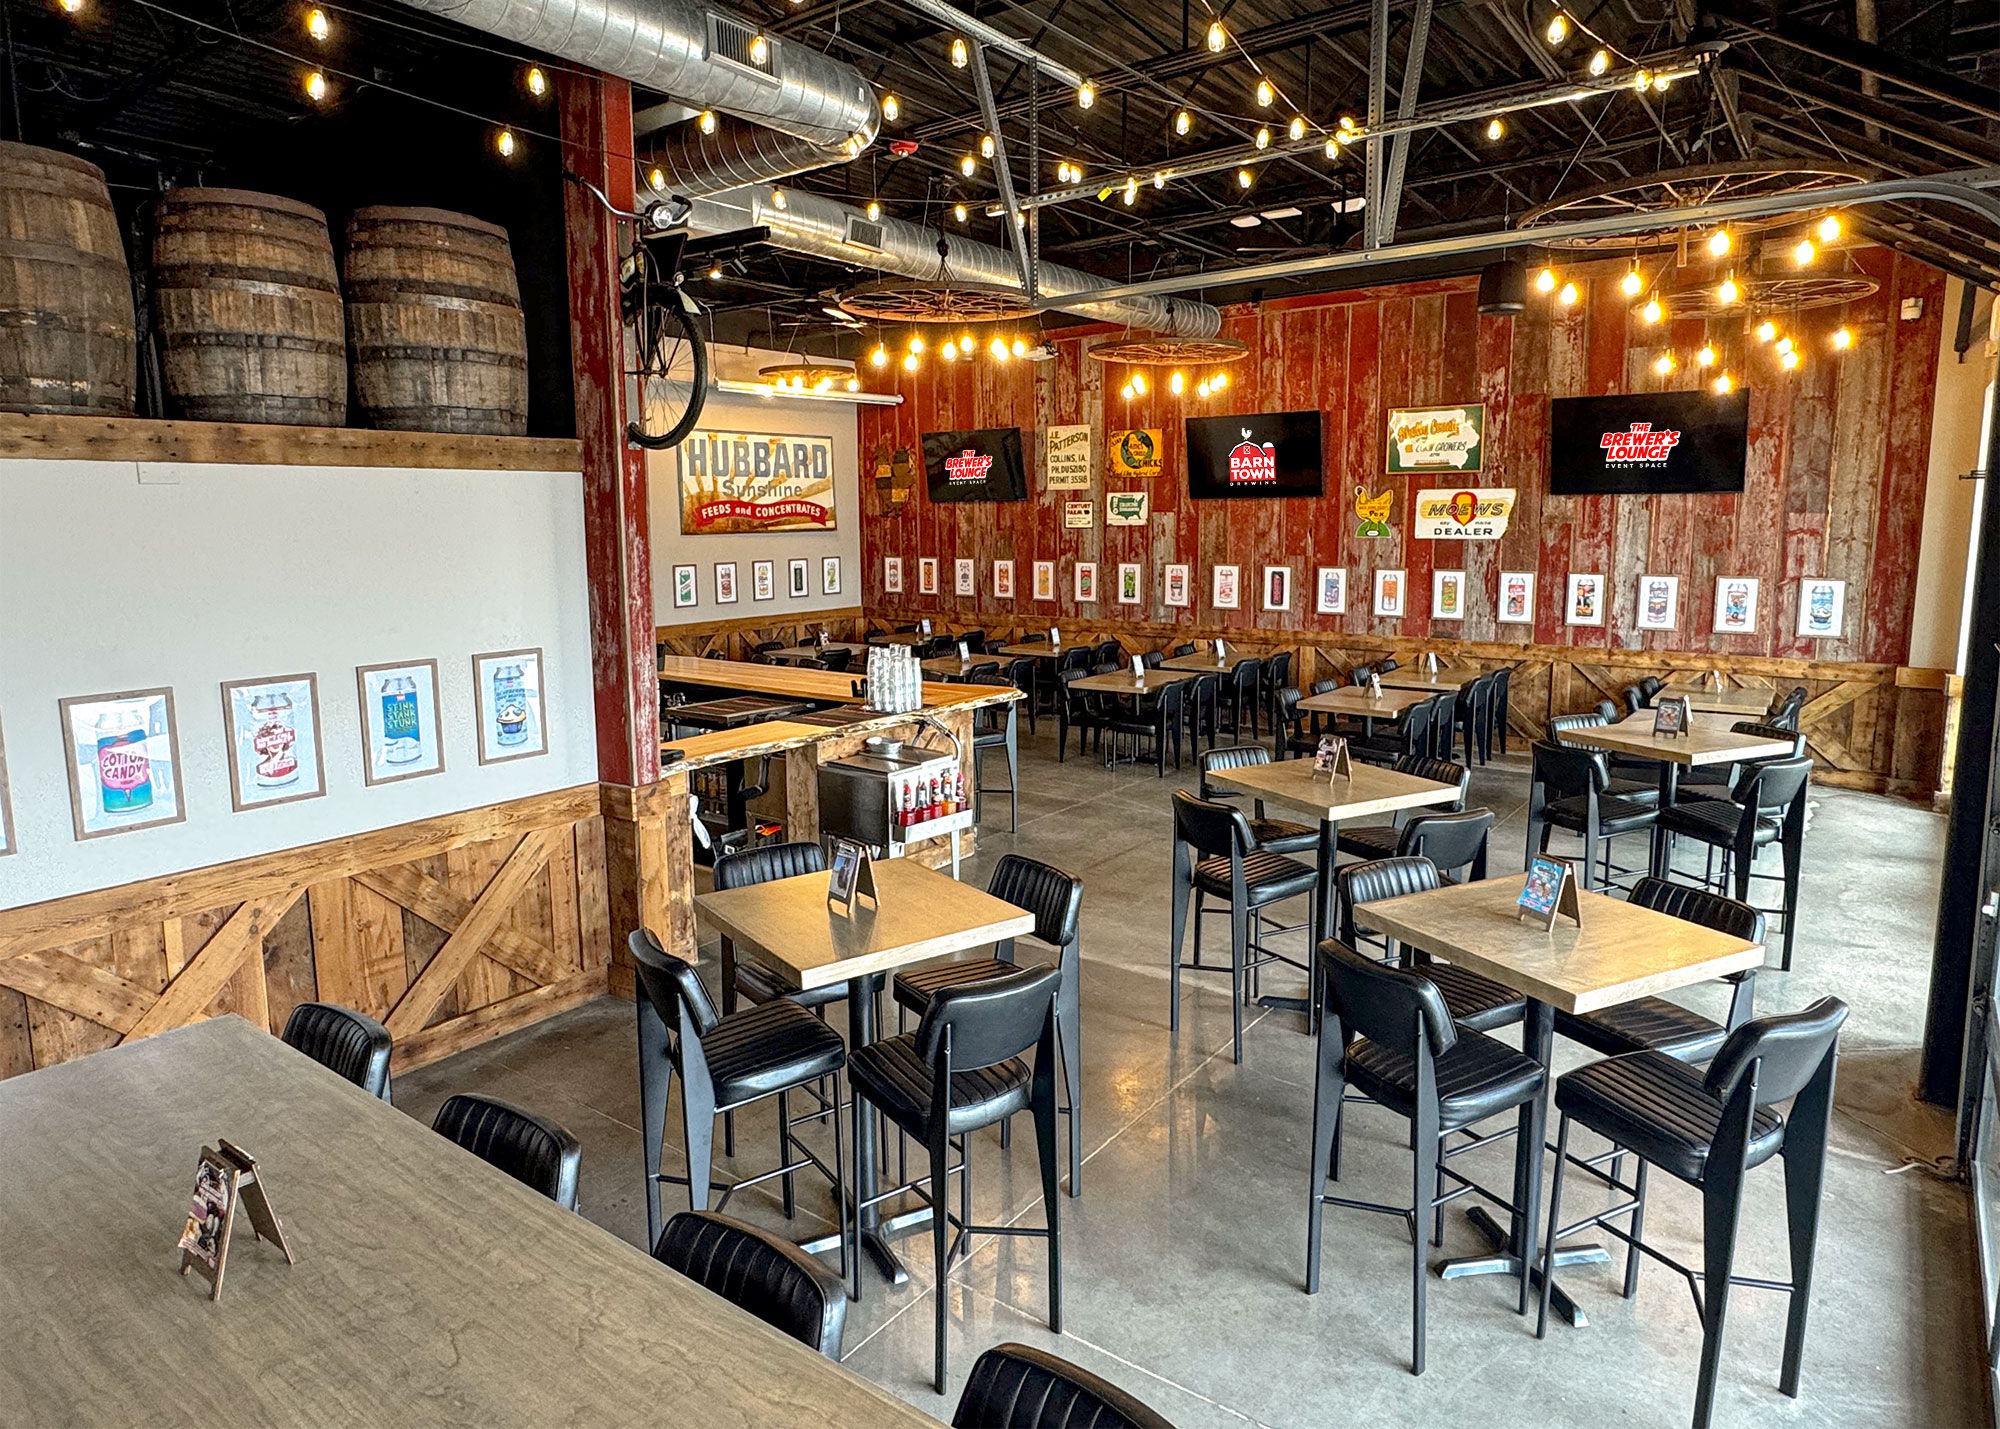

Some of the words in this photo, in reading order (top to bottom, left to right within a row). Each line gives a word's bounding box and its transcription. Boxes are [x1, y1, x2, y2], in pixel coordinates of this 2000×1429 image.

[1630, 423, 1651, 432] THE
[1049, 432, 1088, 455] PATTERSON
[1601, 430, 1680, 446] BREWER'S
[689, 438, 828, 479] HUBBARD
[1607, 446, 1670, 460] LOUNGE
[946, 455, 992, 469] BREWER'S
[1230, 456, 1275, 468] BARN
[950, 467, 987, 479] LOUNGE
[1230, 468, 1275, 480] TOWN
[1049, 476, 1069, 485] PERMIT
[722, 480, 803, 498] Sunshine
[701, 504, 731, 519] FEEDS
[735, 505, 751, 515] and
[755, 503, 821, 517] CONCENTRATES
[1427, 503, 1504, 516] MOEWS
[1434, 528, 1493, 536] DEALER
[103, 752, 144, 768] COTTON
[104, 763, 143, 780] CANDY
